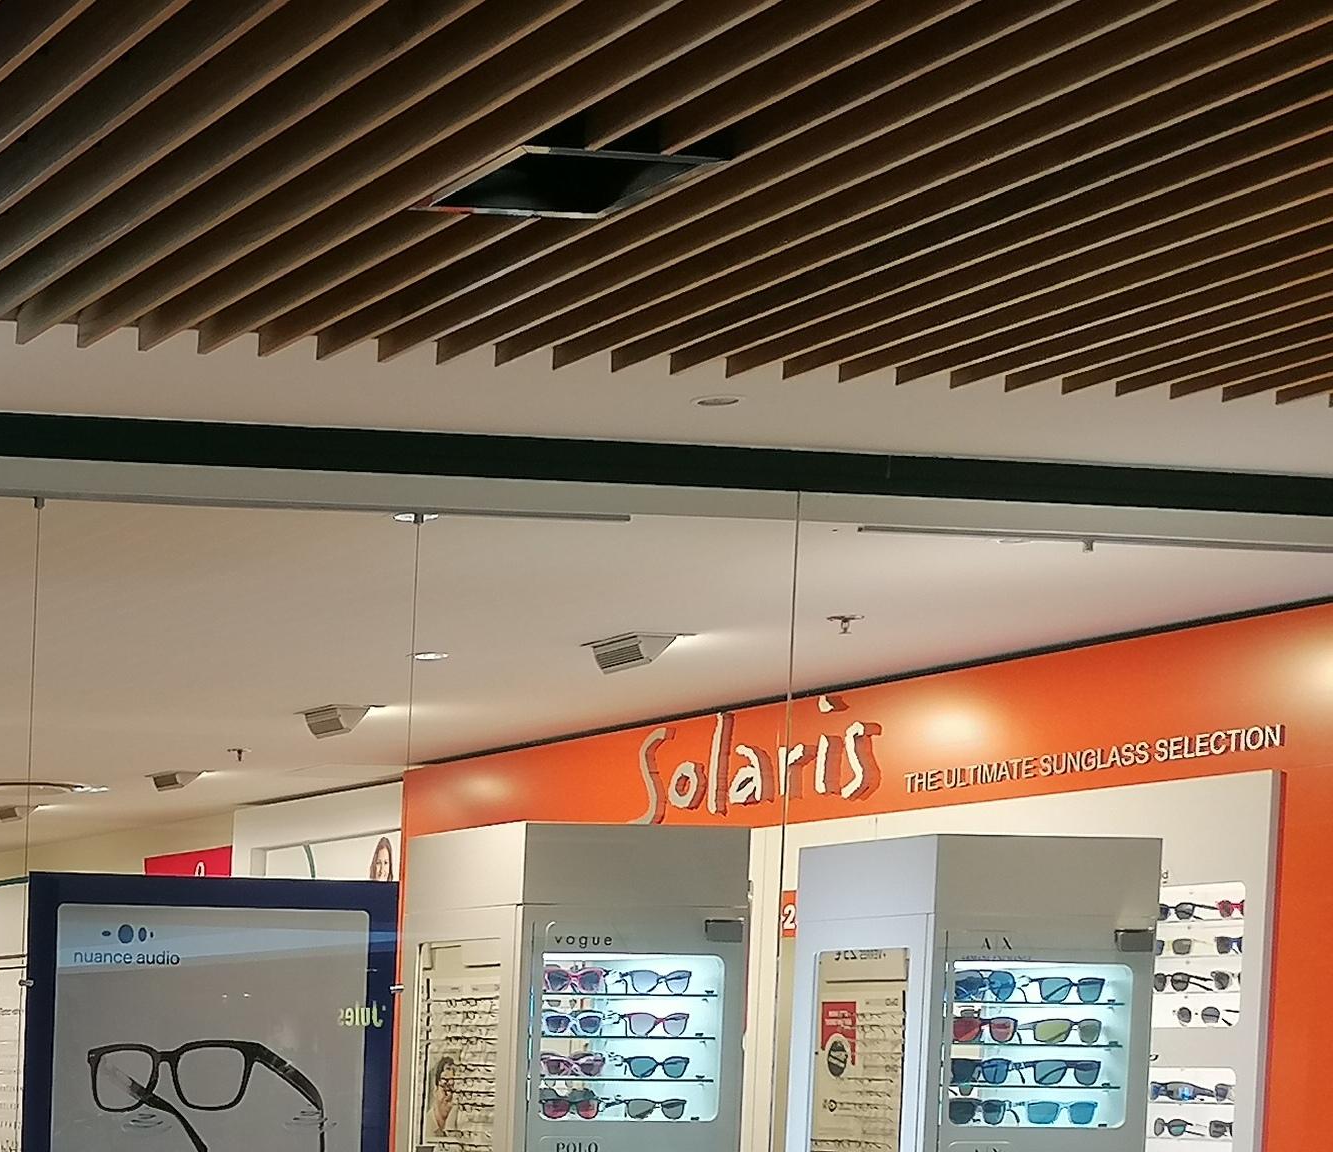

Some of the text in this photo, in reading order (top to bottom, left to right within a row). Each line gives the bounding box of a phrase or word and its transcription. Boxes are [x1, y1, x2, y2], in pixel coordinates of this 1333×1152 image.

[633, 695, 873, 824] Solaris
[904, 724, 1283, 794] THE ULTIMATE SUNGLASS SELECTION
[73, 950, 181, 965] nuance audio
[555, 935, 613, 948] vogue
